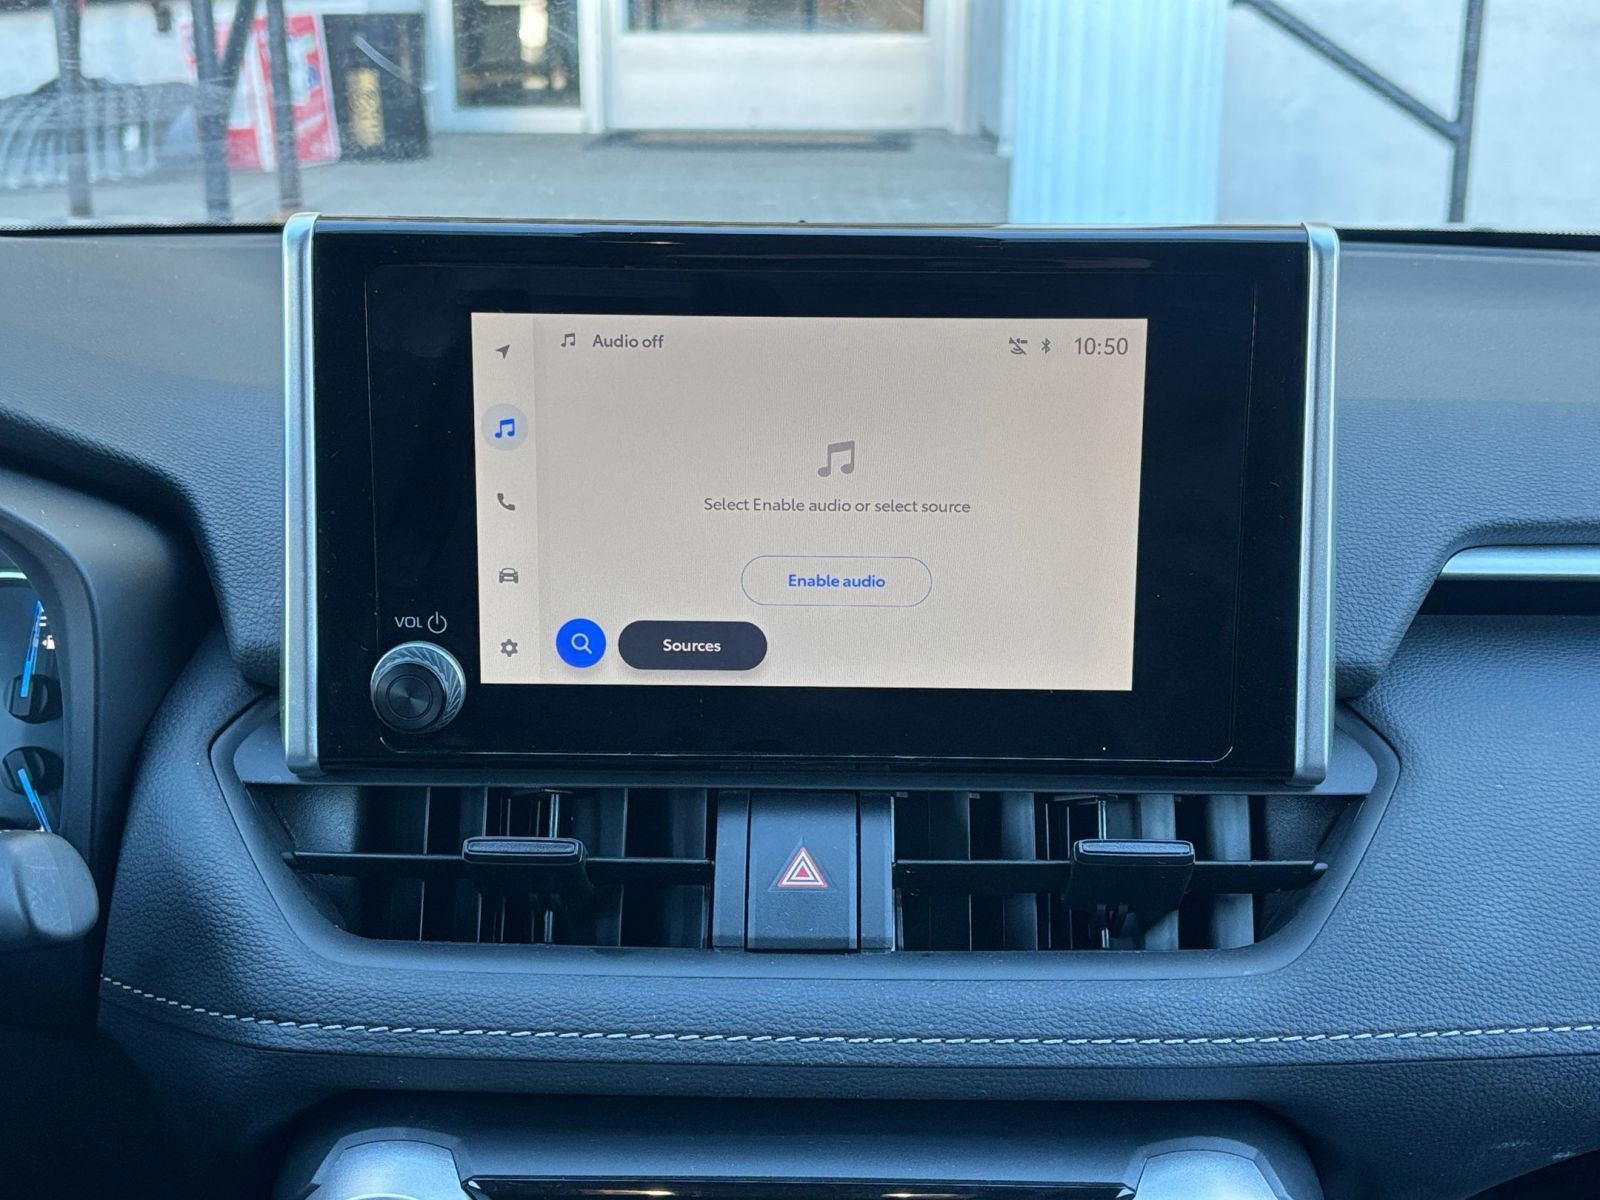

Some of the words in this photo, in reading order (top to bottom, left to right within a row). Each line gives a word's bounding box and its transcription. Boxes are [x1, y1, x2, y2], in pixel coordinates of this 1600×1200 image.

[592, 333, 640, 349] Audio
[642, 333, 665, 349] off
[1075, 336, 1129, 356] 10:50
[703, 496, 750, 512] Select
[753, 497, 805, 512] Enable
[808, 497, 852, 512] audio
[854, 501, 871, 513] or
[874, 498, 919, 513] select
[921, 502, 971, 513] source
[787, 573, 840, 588] Enable
[842, 573, 886, 588] audio
[394, 615, 423, 629] VOL
[662, 638, 722, 653] Sources
